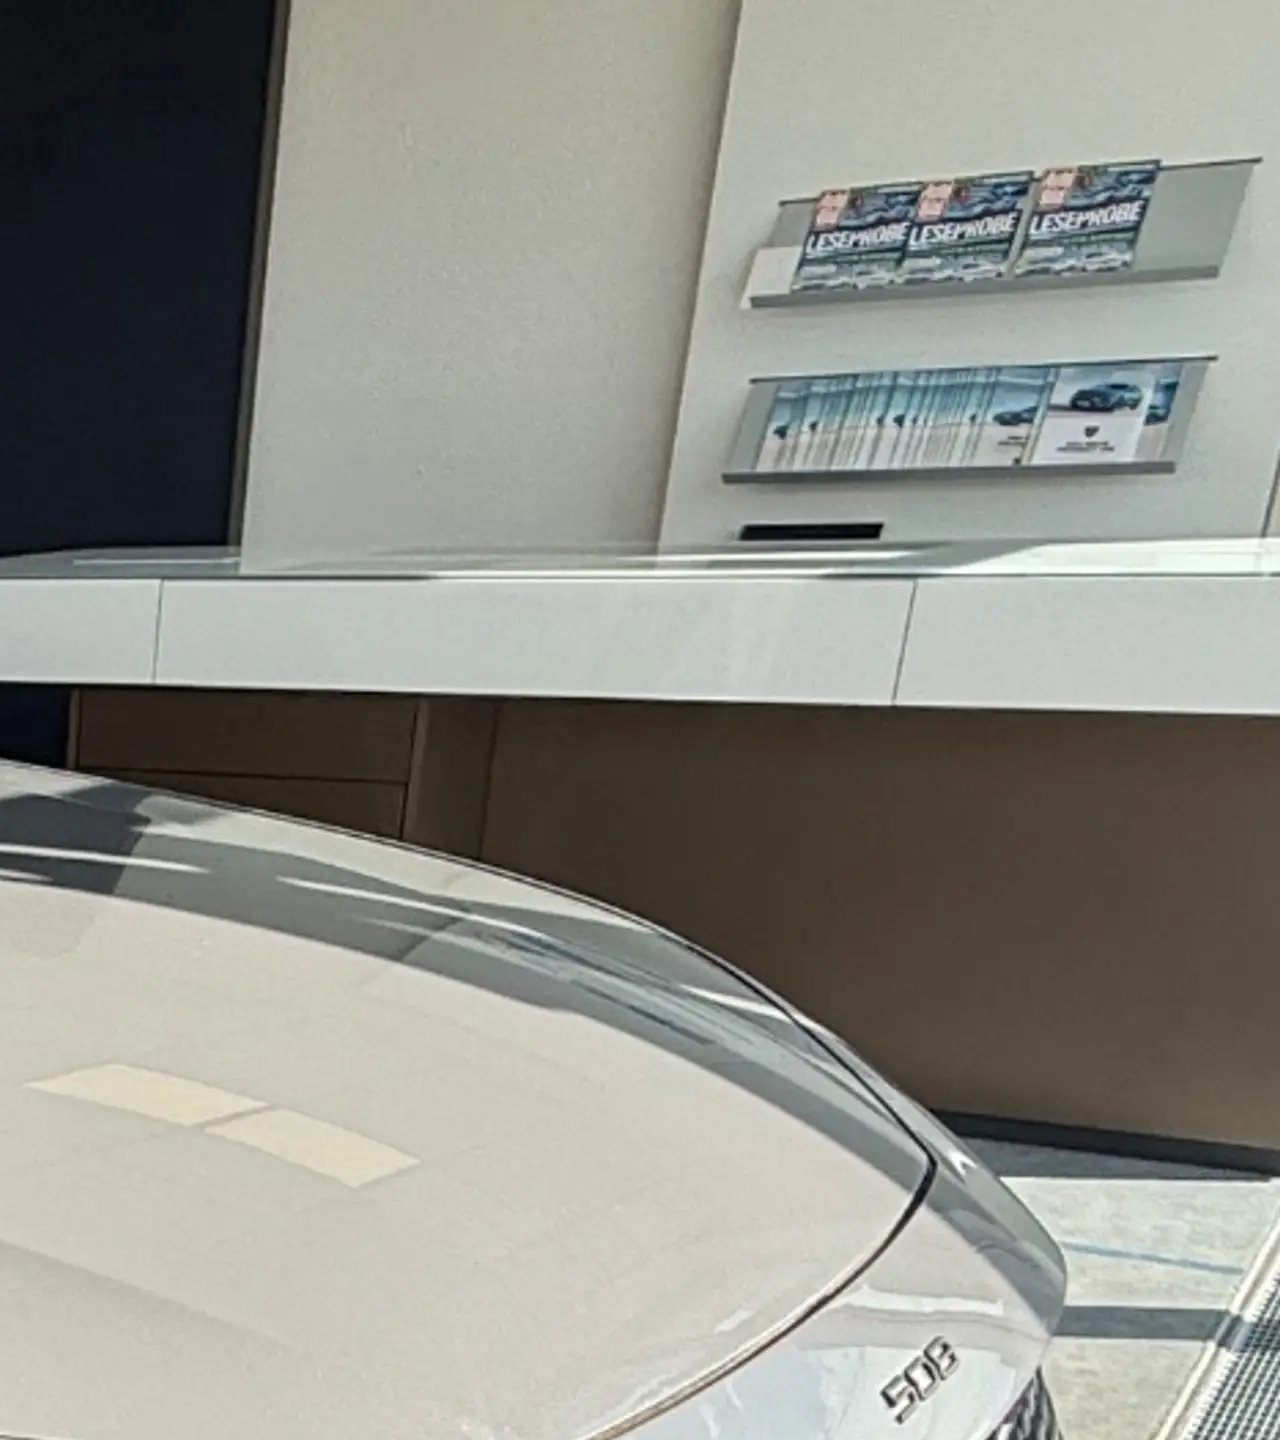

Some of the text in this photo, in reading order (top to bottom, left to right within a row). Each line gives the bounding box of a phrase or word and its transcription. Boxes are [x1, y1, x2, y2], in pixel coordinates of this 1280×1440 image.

[909, 212, 1018, 246] LESEPROBE
[1030, 201, 1144, 235] LESEPROBE
[806, 222, 911, 254] LESEPROBE
[880, 1335, 960, 1425] 508
